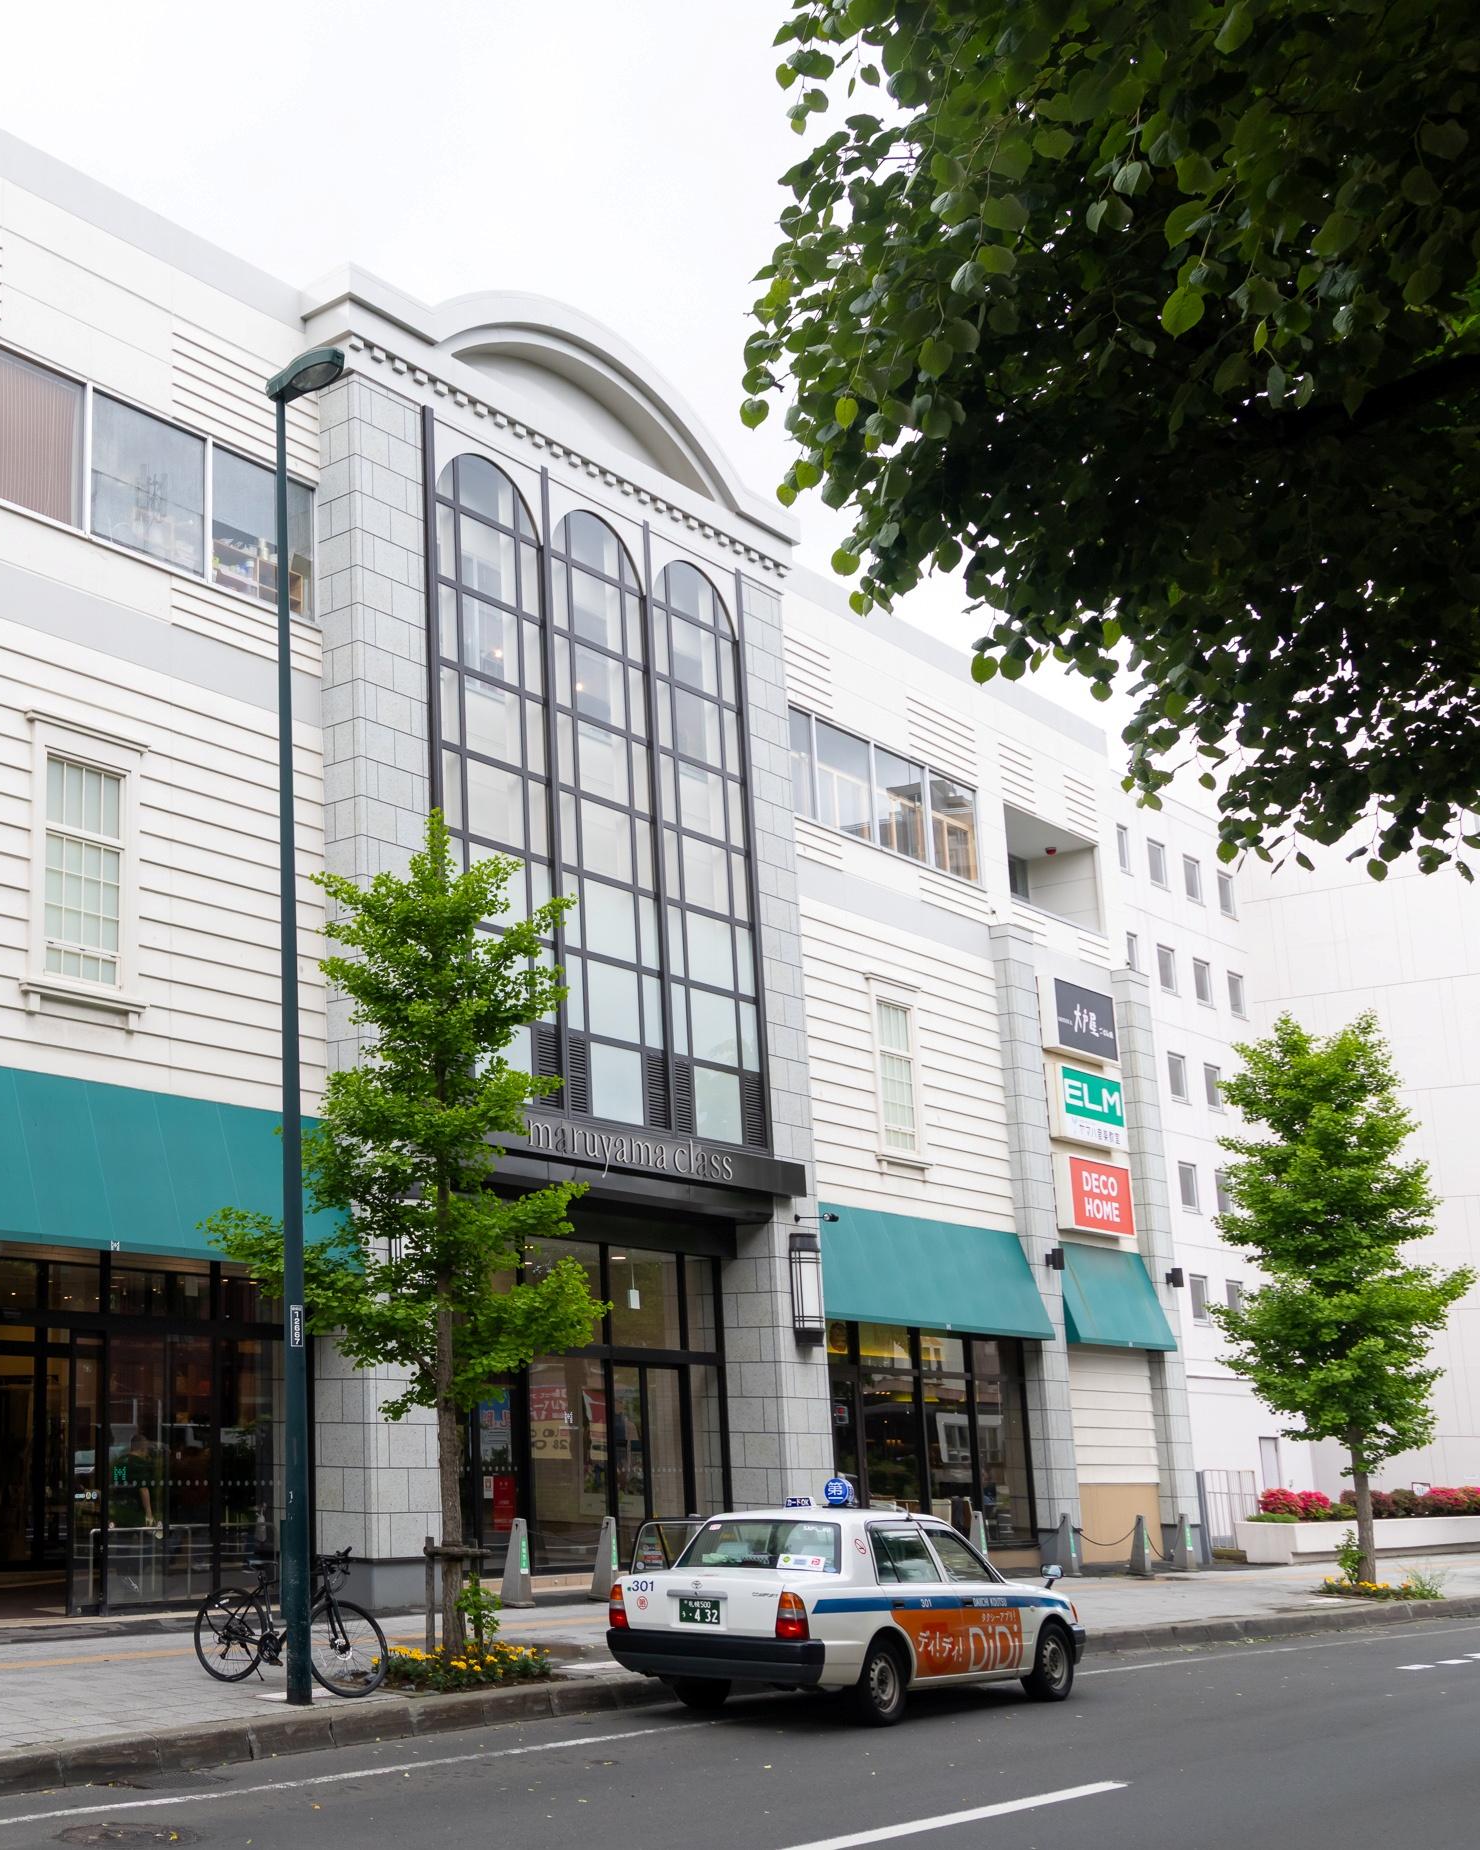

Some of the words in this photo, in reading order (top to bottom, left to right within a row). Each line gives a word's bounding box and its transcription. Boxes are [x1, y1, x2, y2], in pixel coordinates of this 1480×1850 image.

[1063, 1077, 1123, 1117] ELM
[527, 1119, 667, 1178] maruyama
[673, 1138, 733, 1181] class
[1082, 1170, 1118, 1197] DECO
[1084, 1196, 1121, 1223] HOME
[827, 1481, 844, 1500] 第一
[631, 1580, 654, 1592] 301
[920, 1598, 932, 1608] 301
[968, 1624, 1020, 1672] DiDi
